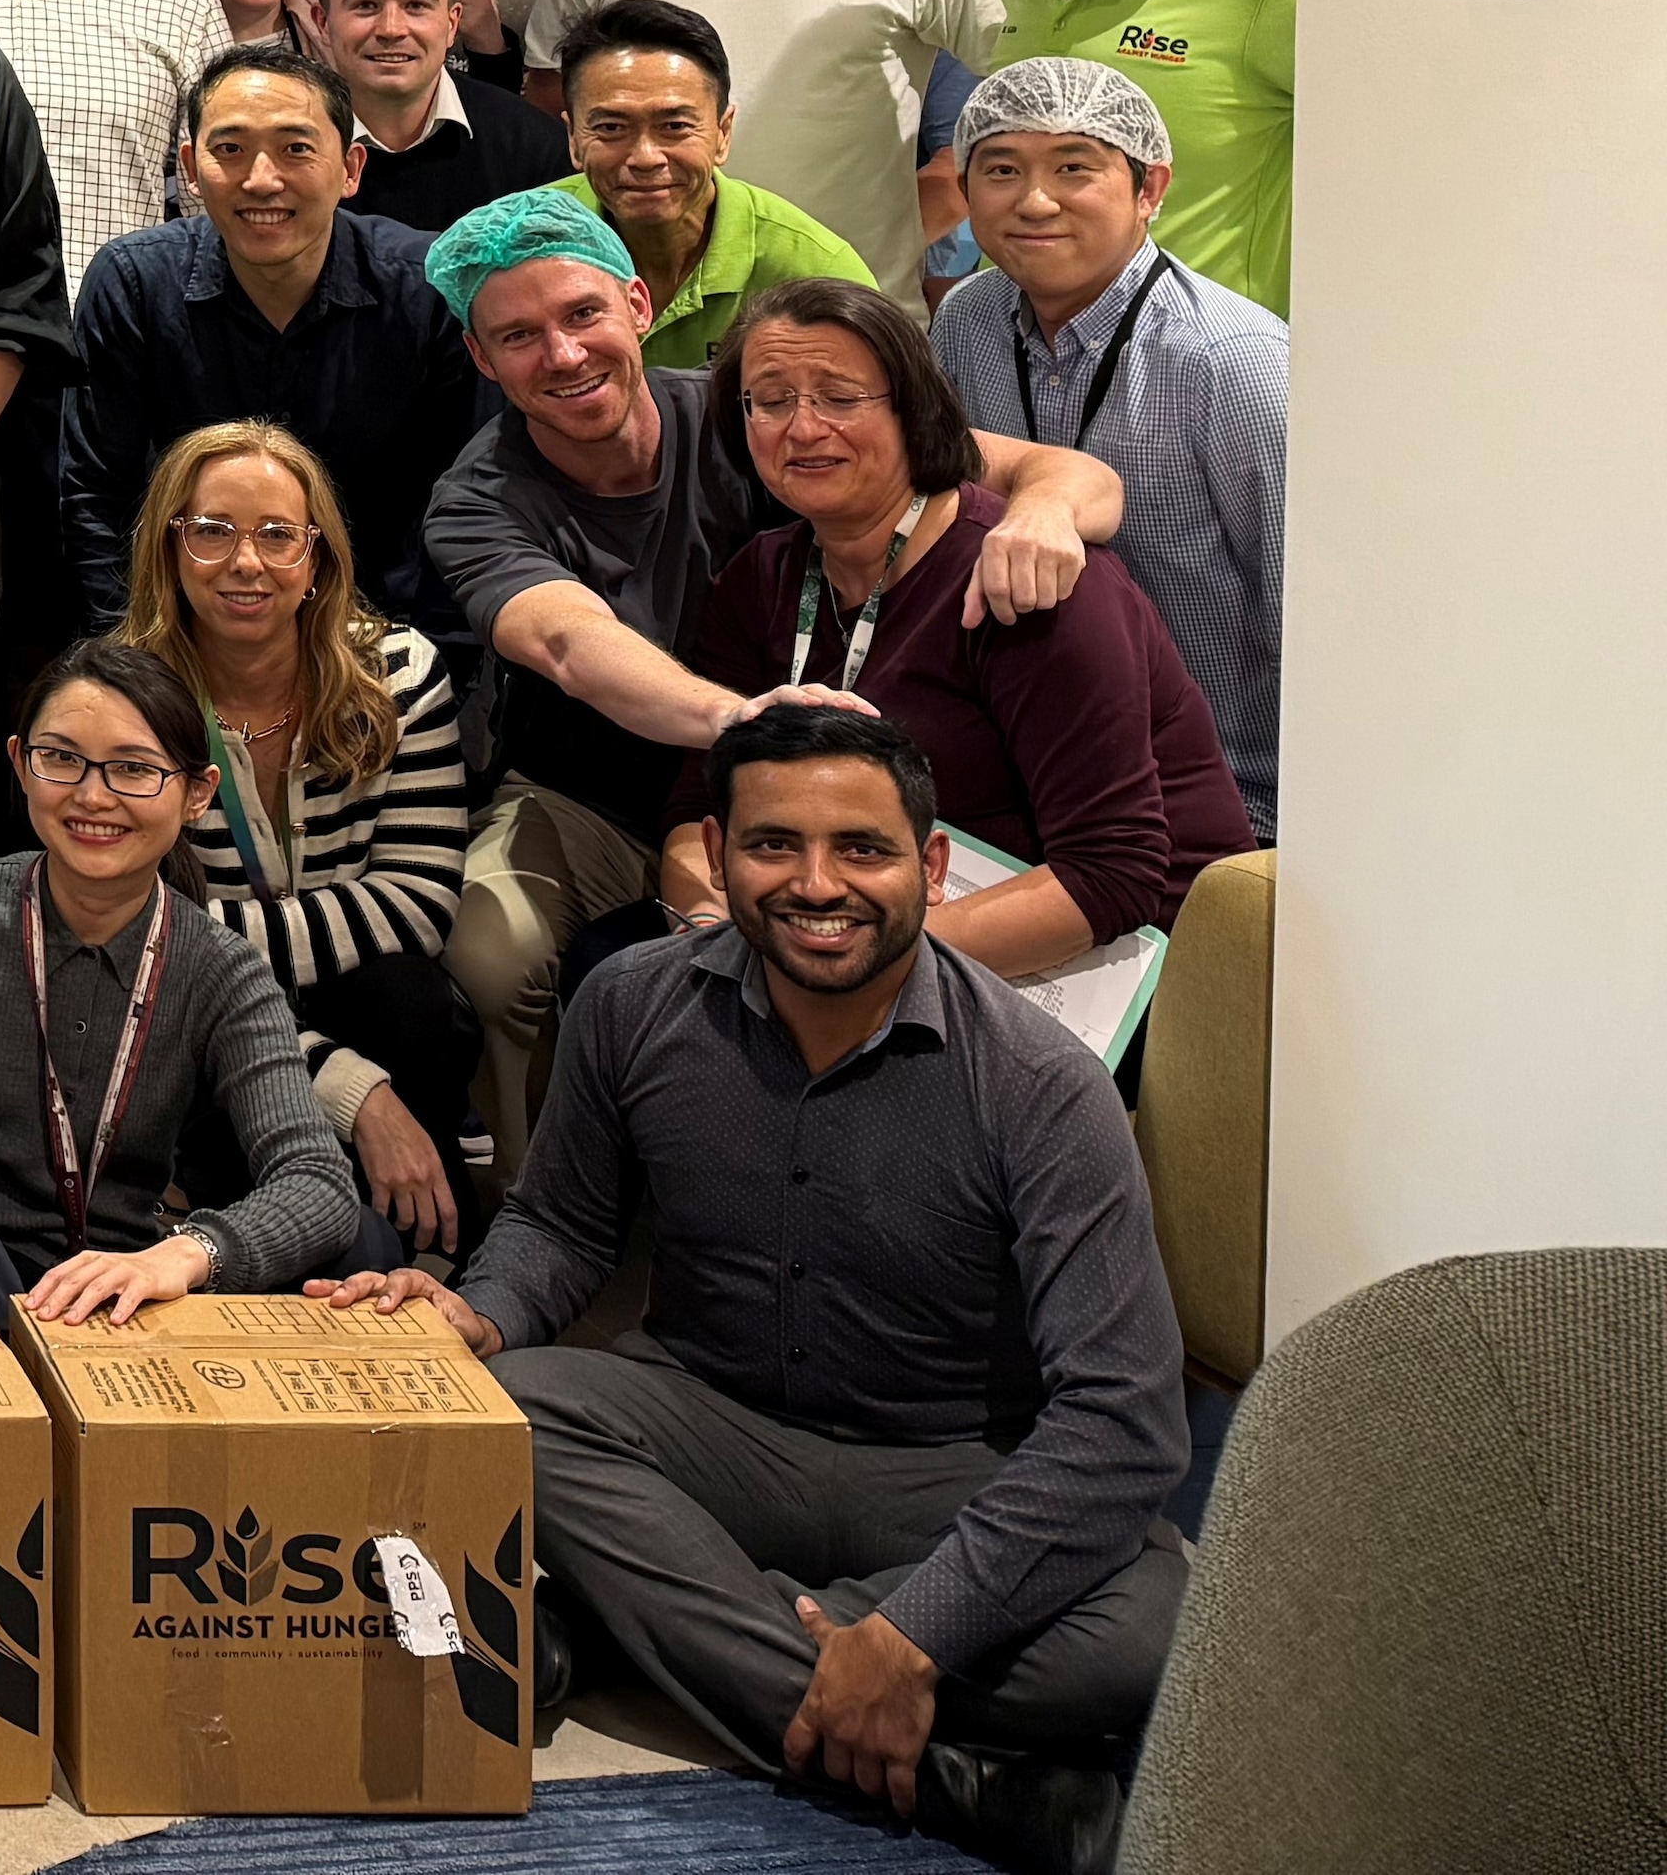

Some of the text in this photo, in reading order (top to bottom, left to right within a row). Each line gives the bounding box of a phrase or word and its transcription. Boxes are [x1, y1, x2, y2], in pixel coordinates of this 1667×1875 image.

[1120, 25, 1189, 55] Rise
[132, 1615, 273, 1639] AGAINST
[287, 1615, 395, 1639] HUNGE
[172, 1648, 384, 1661] food community sustainability
